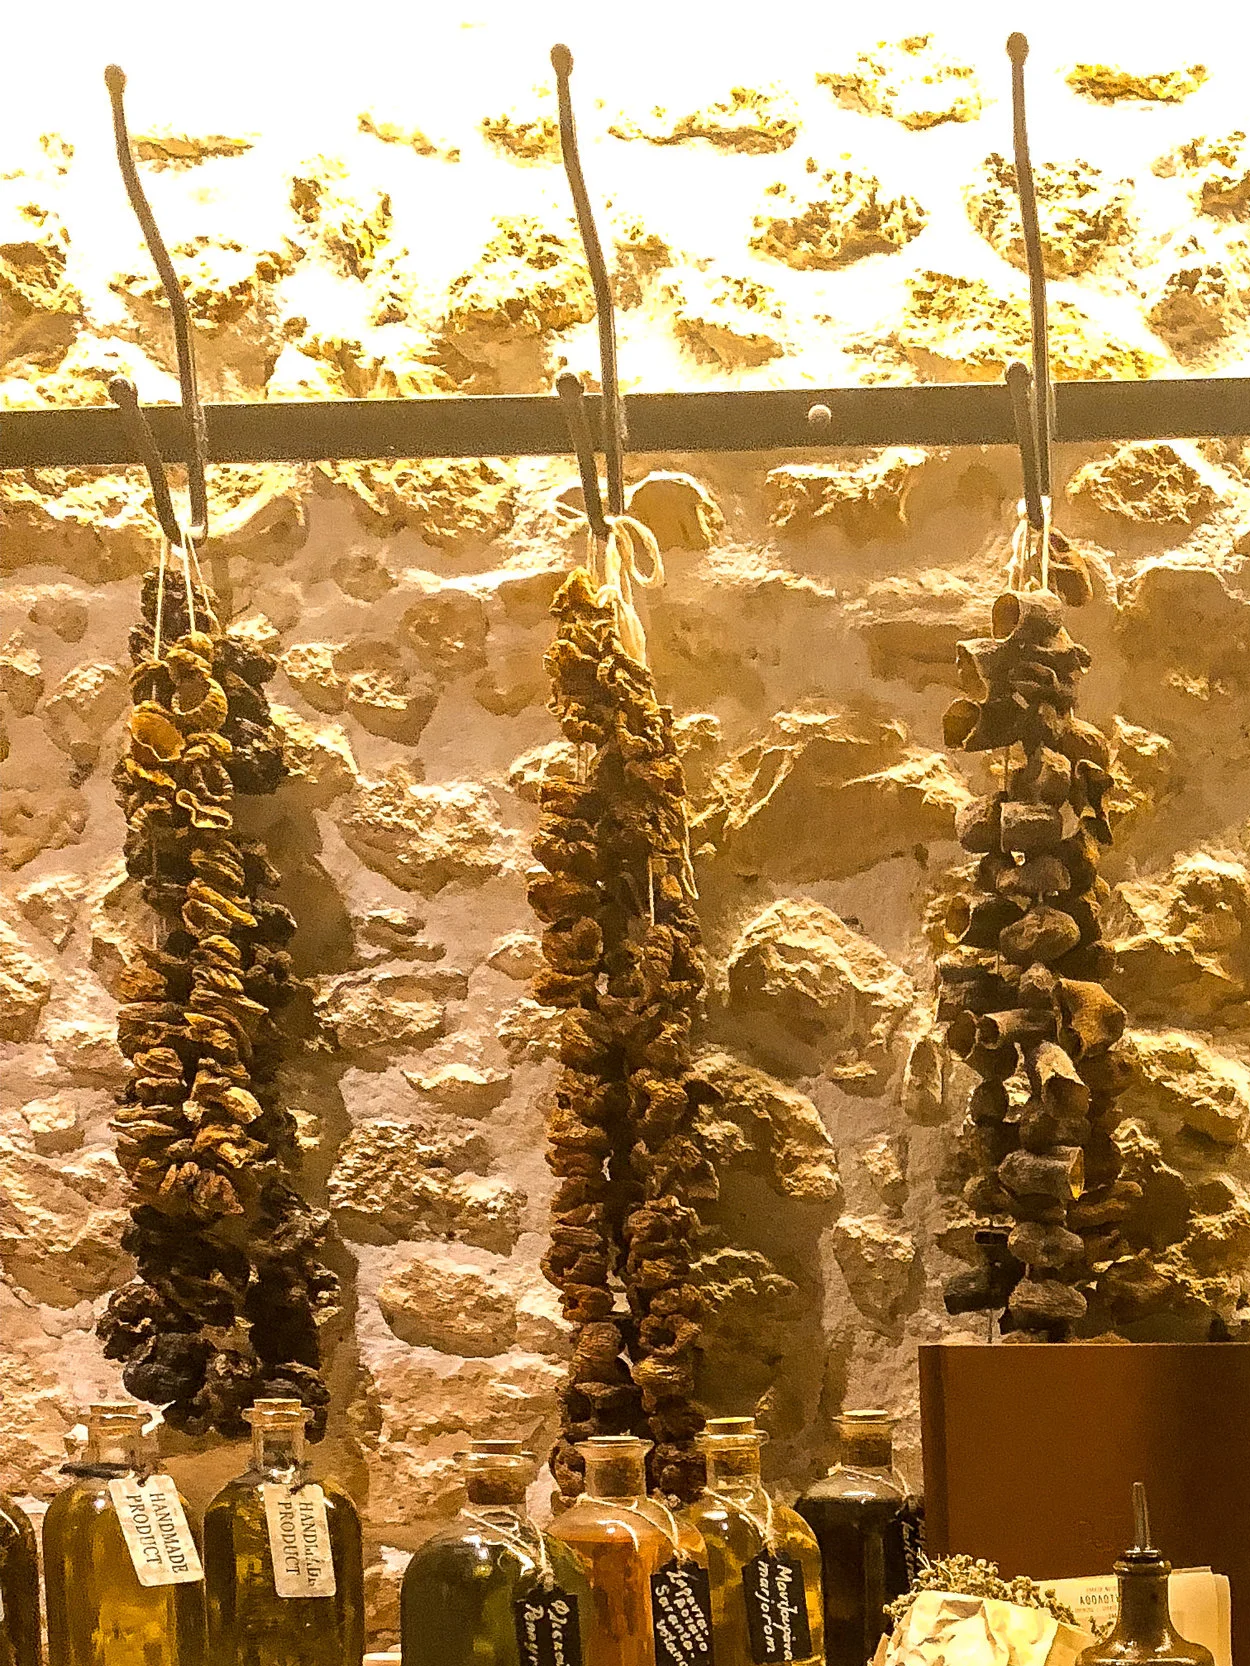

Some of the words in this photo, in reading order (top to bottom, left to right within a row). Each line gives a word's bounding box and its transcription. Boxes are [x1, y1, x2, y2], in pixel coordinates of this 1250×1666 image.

[126, 1493, 163, 1564] PRODUCT
[149, 1490, 188, 1573] HANDMADE
[277, 1501, 300, 1575] PRODUCT
